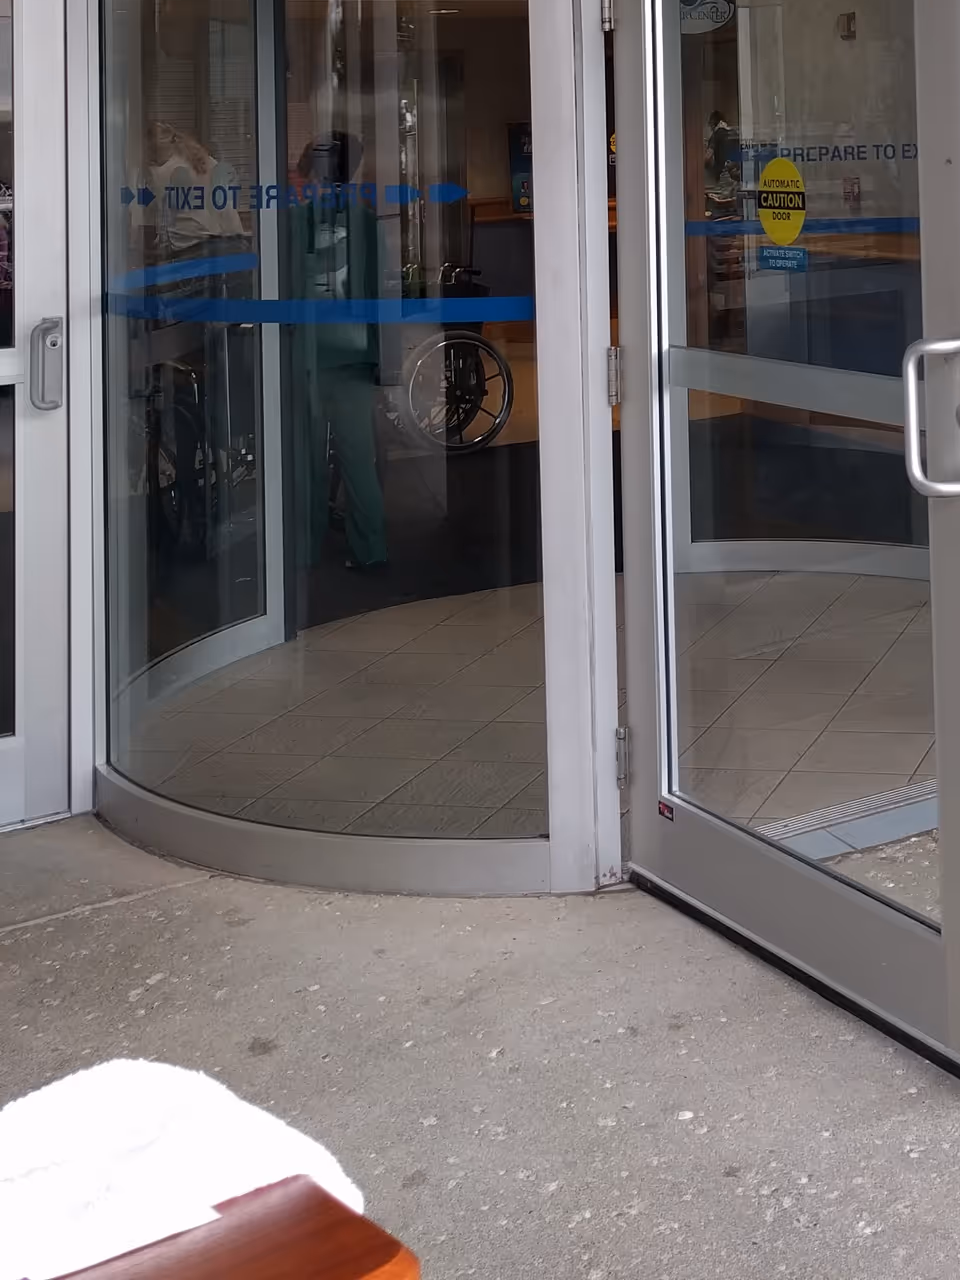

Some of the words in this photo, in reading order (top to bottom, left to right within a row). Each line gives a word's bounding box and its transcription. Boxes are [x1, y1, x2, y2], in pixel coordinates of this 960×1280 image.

[780, 145, 867, 162] PREPARE
[872, 144, 896, 160] TO
[763, 179, 800, 188] AUTOMATIC
[760, 194, 802, 208] CAUTION
[772, 212, 792, 220] DOOR
[763, 250, 784, 258] ACTIVATE
[786, 250, 802, 259] SWITCH
[776, 260, 798, 268] OPERATE
